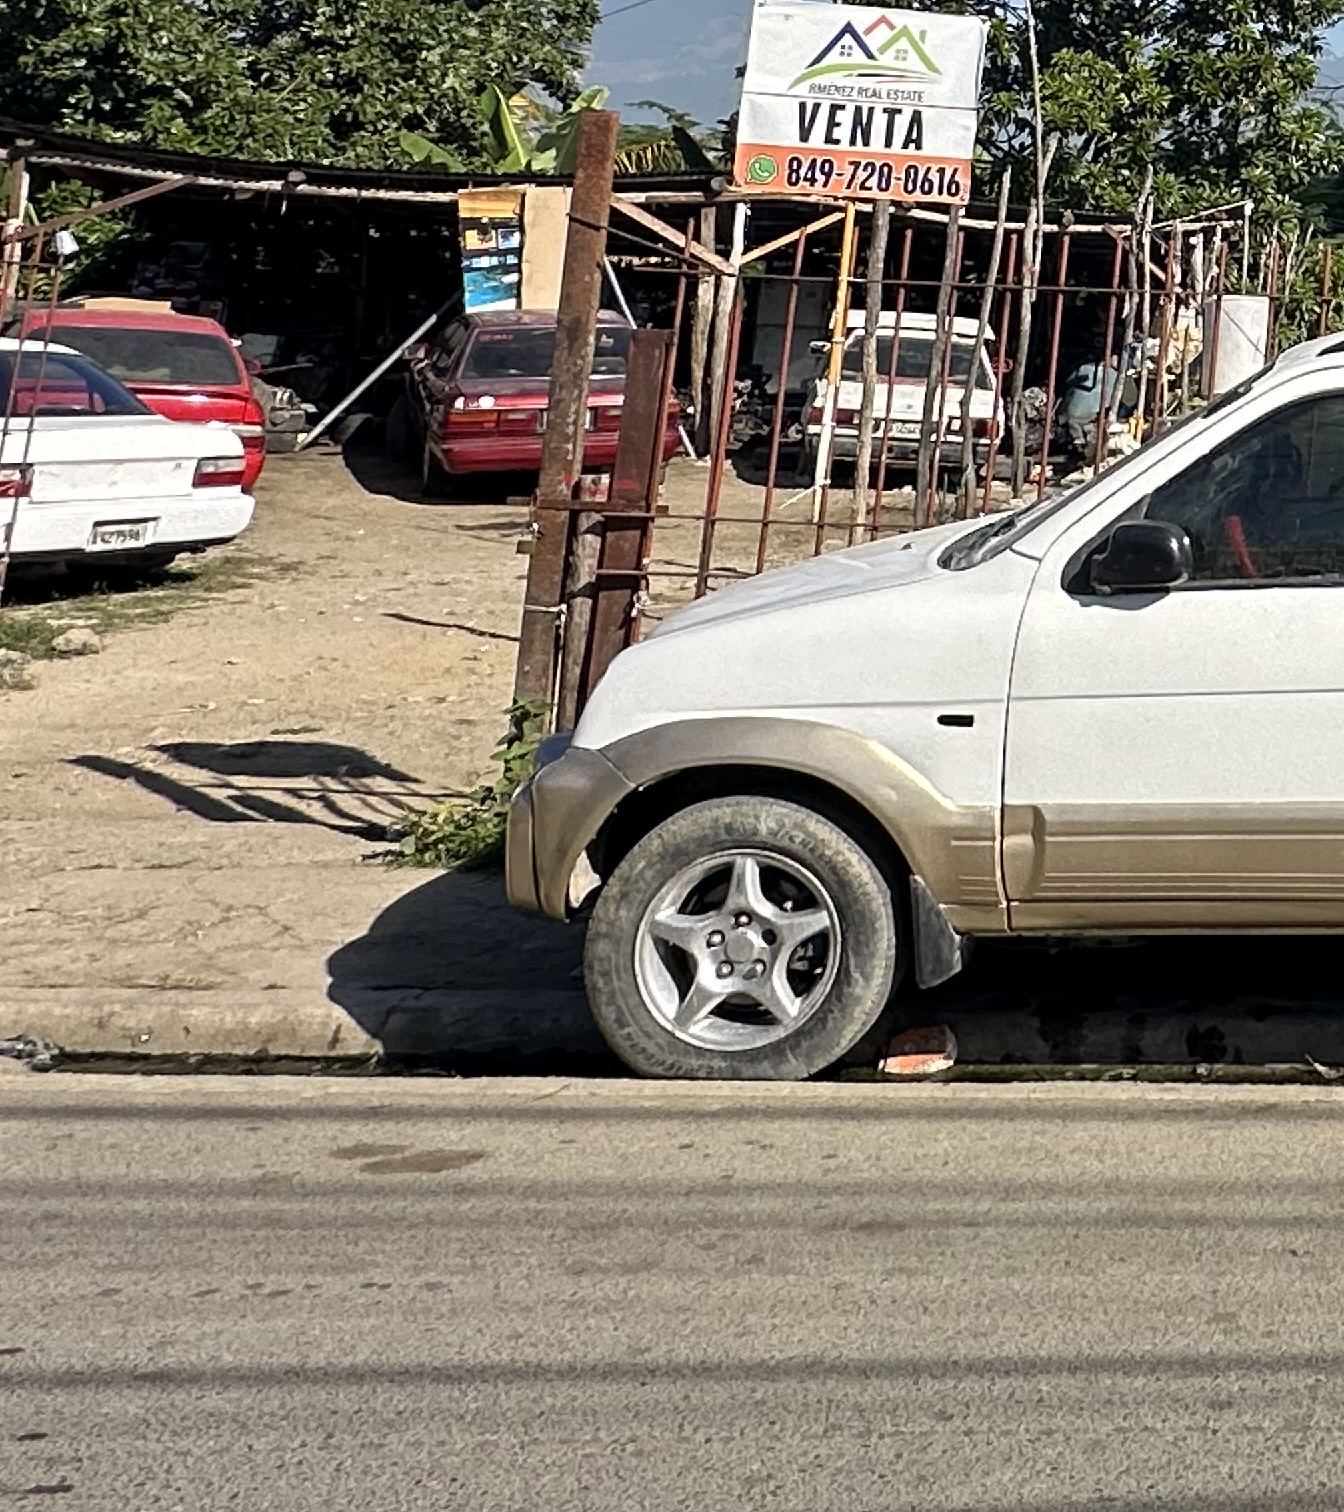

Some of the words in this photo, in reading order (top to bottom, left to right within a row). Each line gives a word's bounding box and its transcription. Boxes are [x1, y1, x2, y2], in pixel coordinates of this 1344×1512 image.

[857, 86, 884, 100] REAL
[886, 88, 926, 103] ESTATE
[798, 101, 923, 151] VENTA
[786, 156, 961, 198] 849-720-0616
